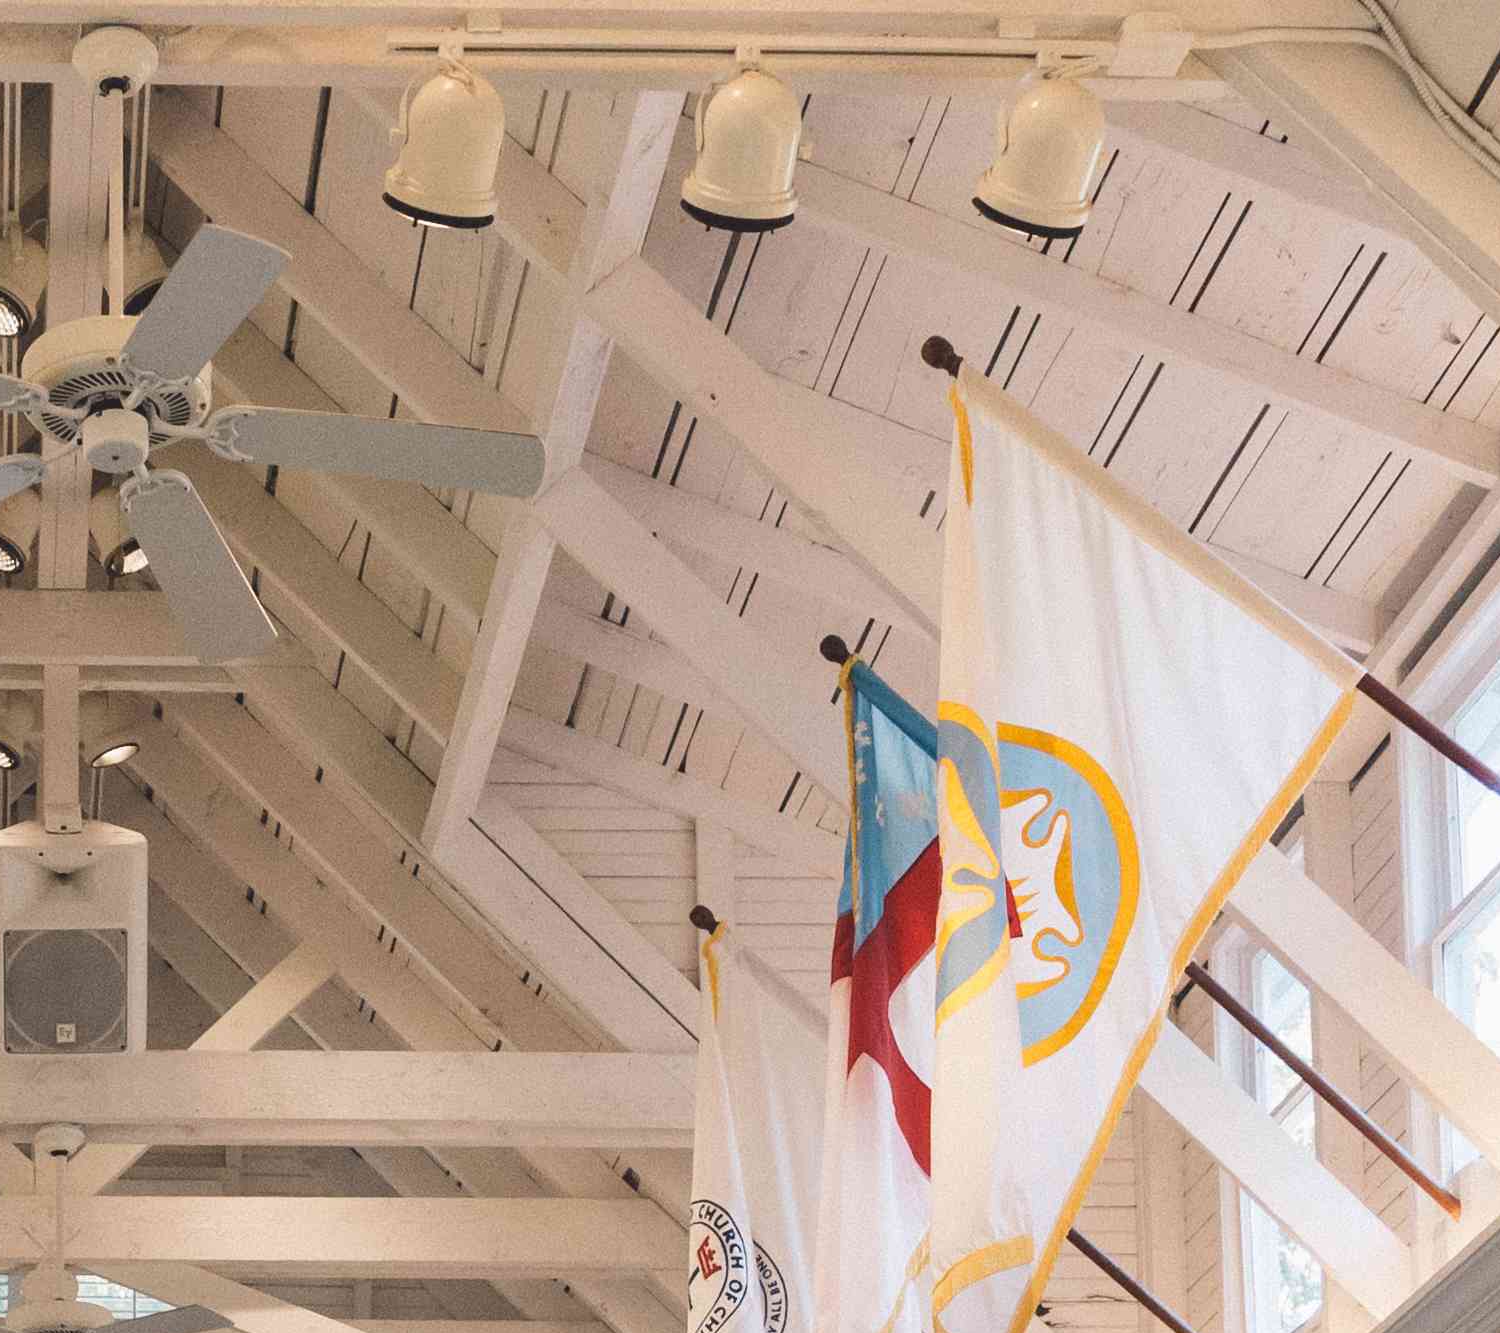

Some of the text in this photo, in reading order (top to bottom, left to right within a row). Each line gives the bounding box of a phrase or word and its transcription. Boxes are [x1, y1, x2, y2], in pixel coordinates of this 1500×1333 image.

[698, 1204, 745, 1270] CHURCH
[725, 1279, 743, 1304] OF
[768, 1280, 780, 1297] BE
[771, 1299, 782, 1322] ALL
